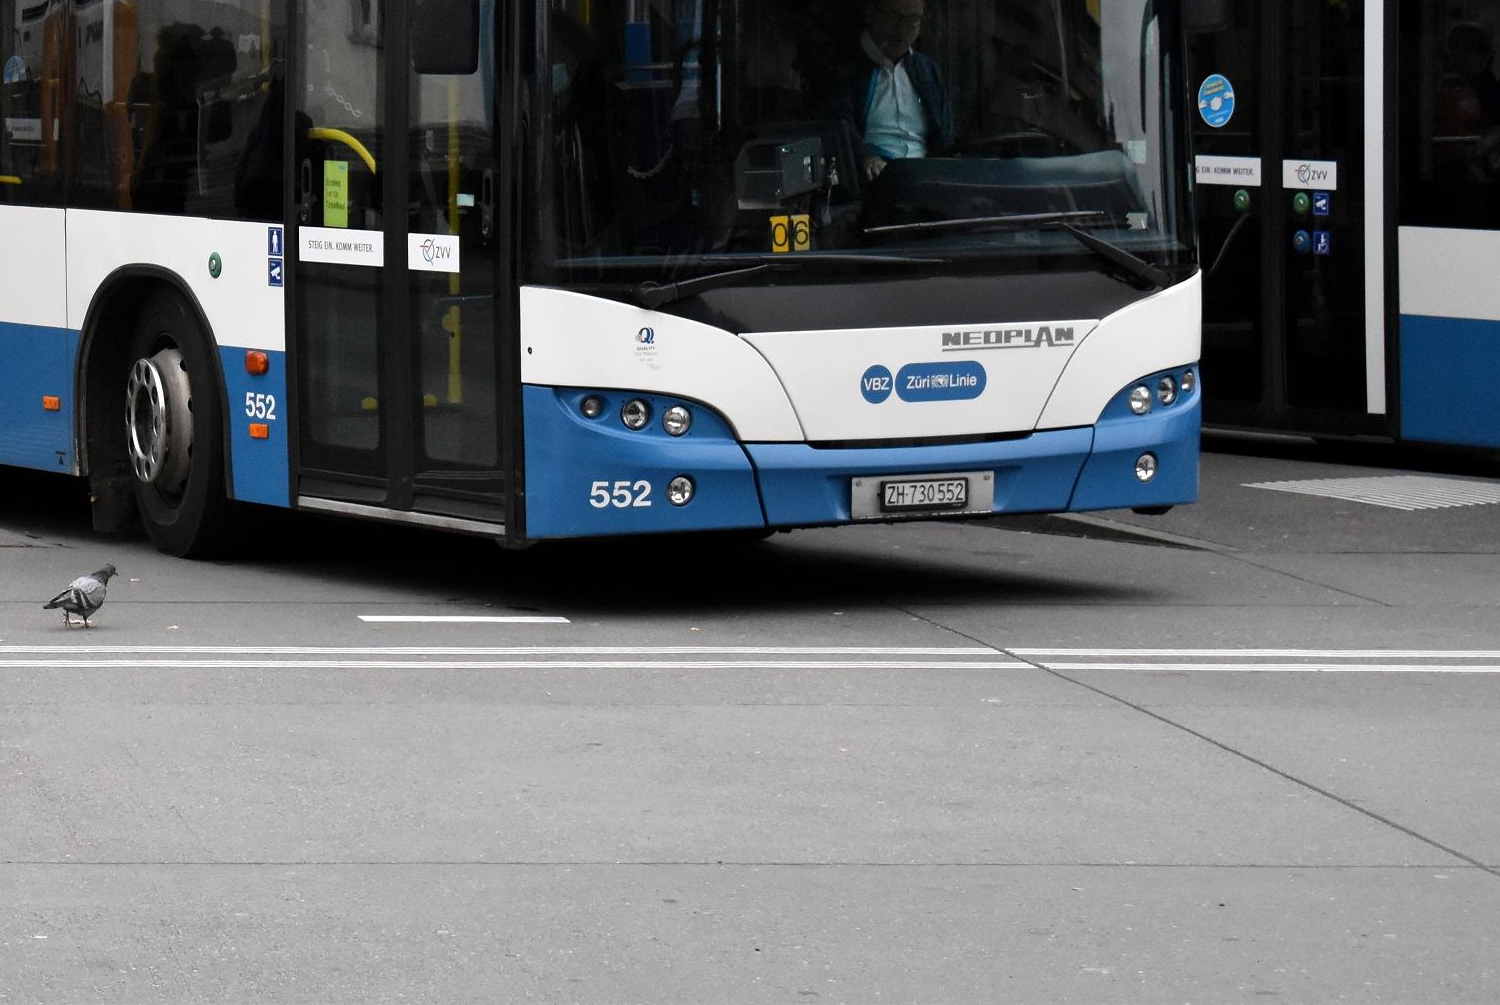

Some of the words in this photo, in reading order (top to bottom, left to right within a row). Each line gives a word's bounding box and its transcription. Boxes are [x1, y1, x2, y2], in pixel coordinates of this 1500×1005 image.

[1311, 170, 1327, 181] ZVV
[308, 240, 323, 250] STEIG
[324, 240, 333, 251] EIN.
[335, 241, 352, 252] KOMM
[353, 242, 375, 253] WEITER.
[435, 246, 451, 259] ZVV
[941, 325, 1074, 348] NEOPLAN
[863, 376, 890, 392] VBZ
[906, 375, 930, 390] Züri
[949, 373, 977, 388] Linie
[245, 391, 276, 420] 552
[589, 479, 652, 508] 552
